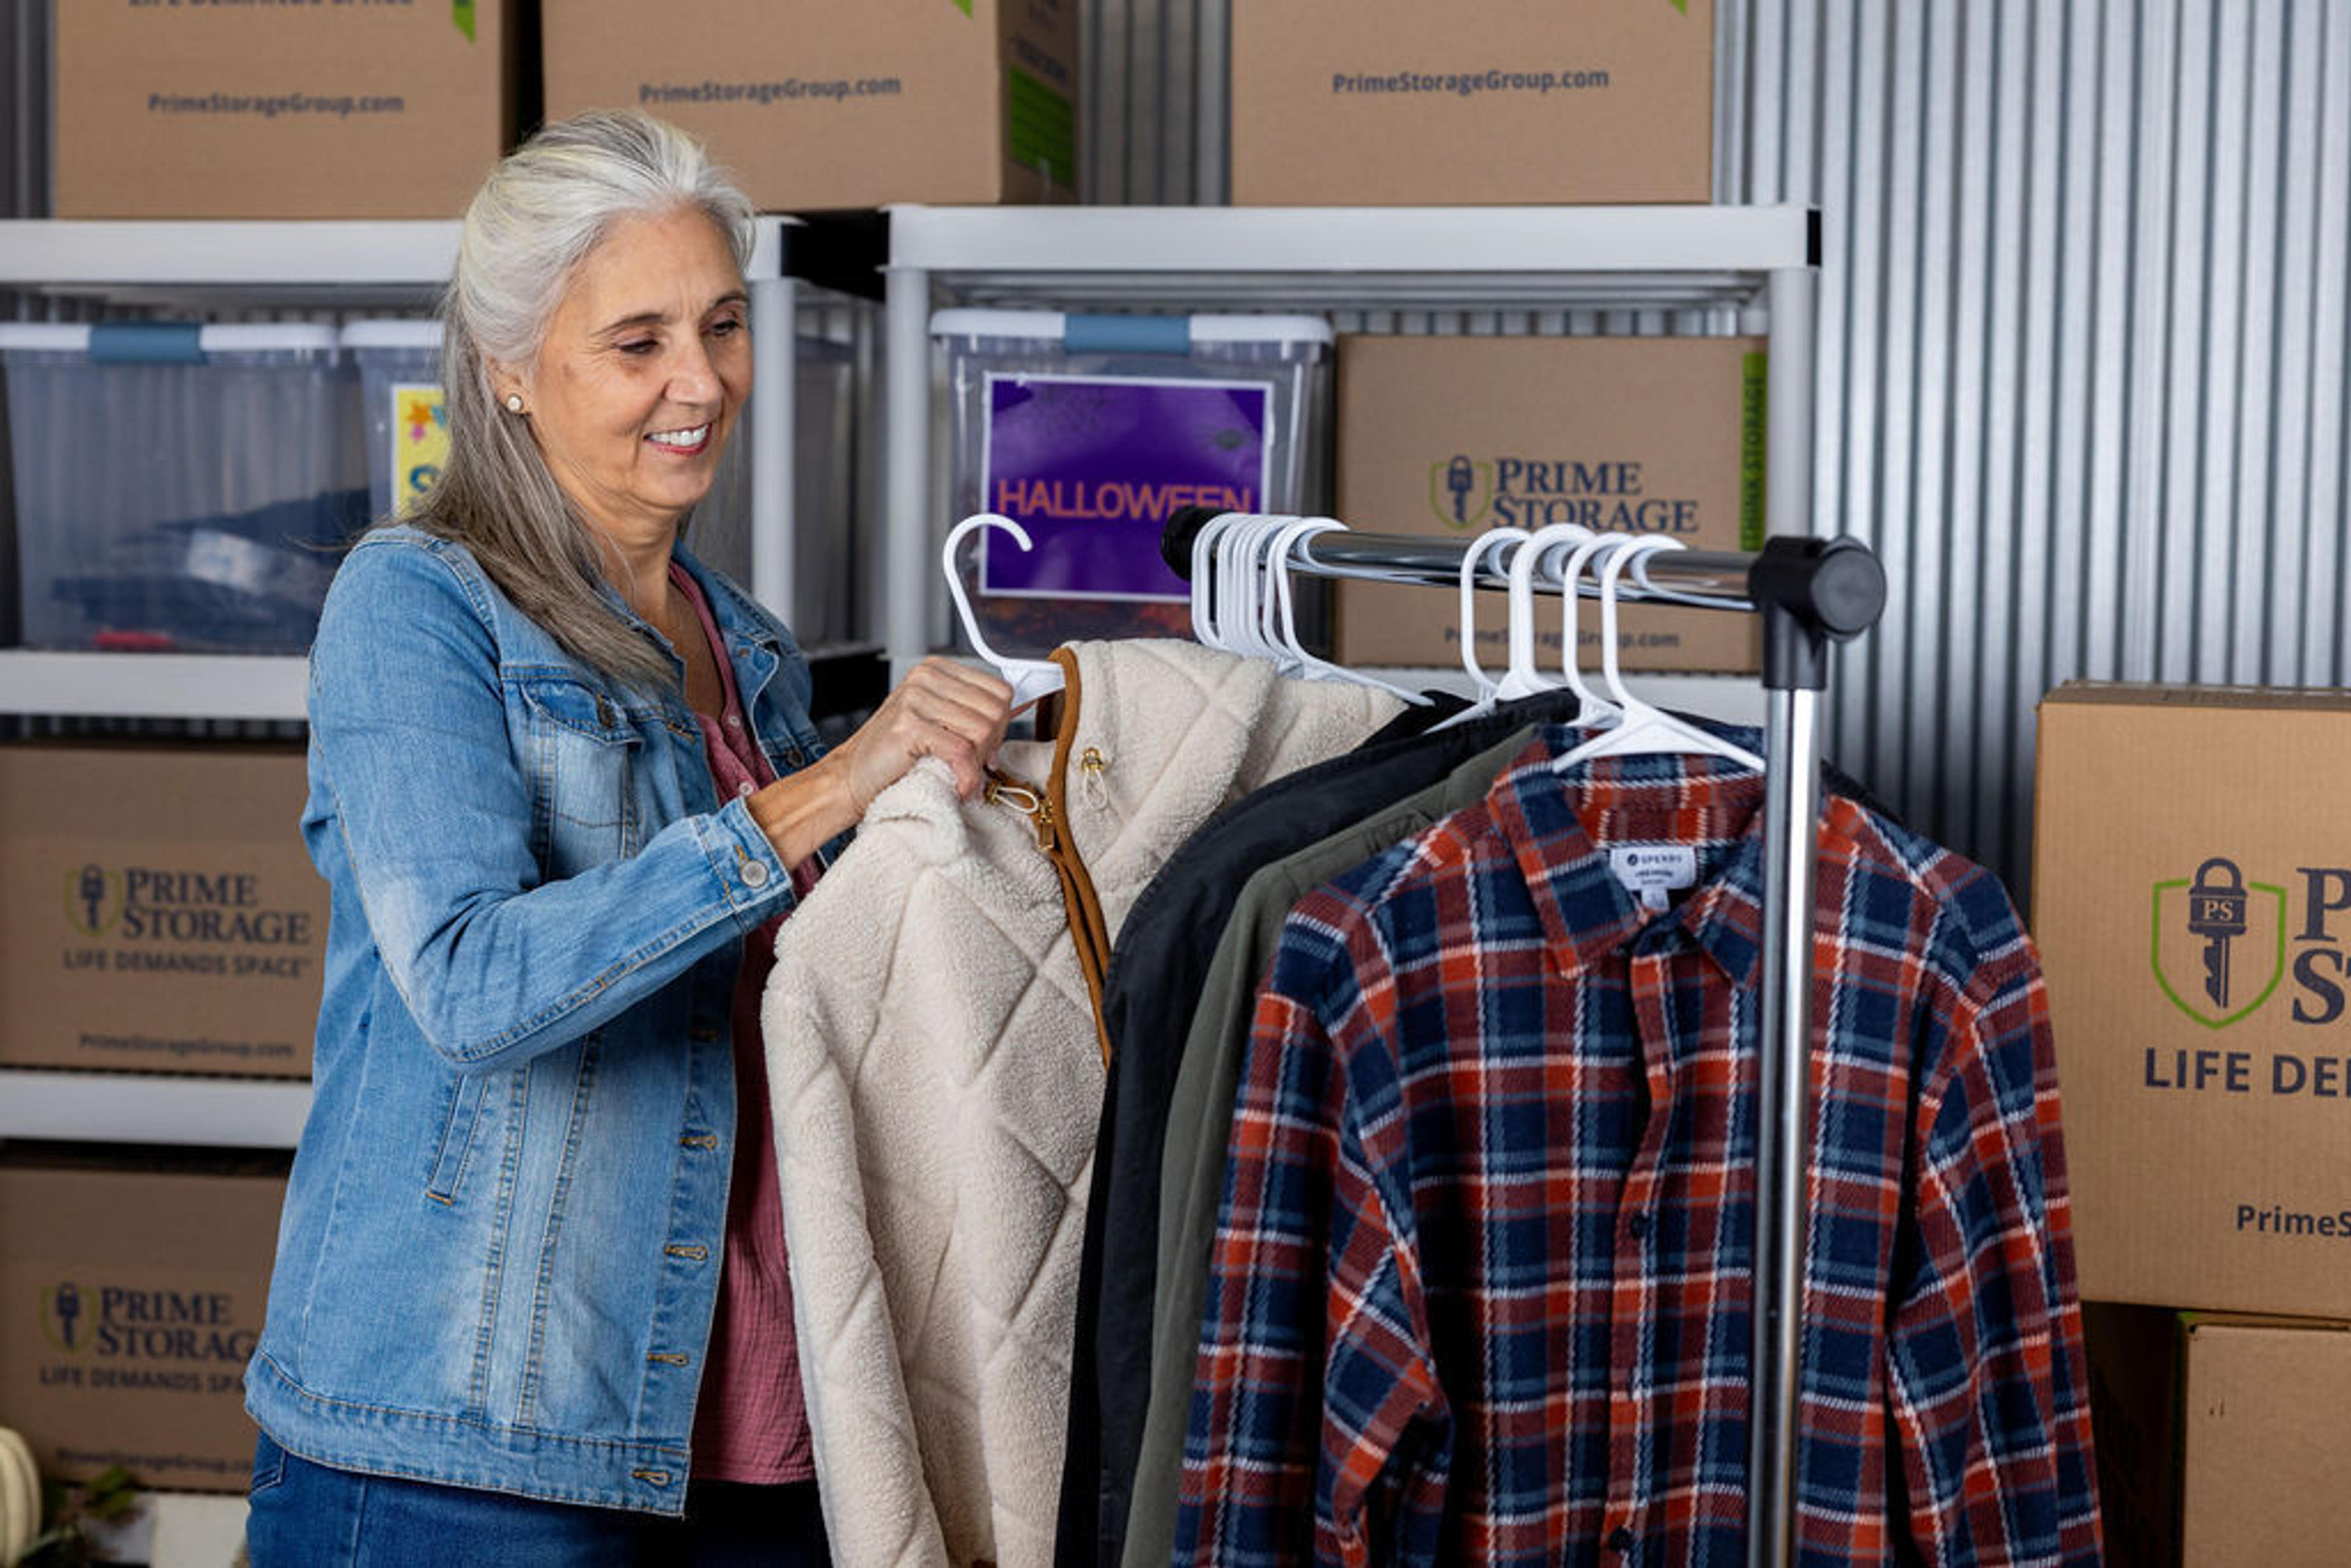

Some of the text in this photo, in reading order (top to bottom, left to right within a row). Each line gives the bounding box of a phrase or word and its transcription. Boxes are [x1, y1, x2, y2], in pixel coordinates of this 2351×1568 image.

[640, 75, 901, 103] PrimeStorageGroup.com
[1332, 70, 1609, 94] PrimeStorageGroup.com
[148, 93, 404, 116] PrimeStorageGroup.com
[1495, 459, 1642, 495] PRIME
[999, 479, 1250, 520] HALLOWEEN
[1491, 495, 1698, 533] STORAGE
[125, 868, 257, 906] PRIME
[122, 906, 311, 945] STORAGE
[2204, 899, 2233, 921] PS
[64, 950, 110, 969] LIFE
[117, 951, 227, 974] DEMANDS
[2292, 948, 2351, 1025] S
[2145, 1048, 2351, 1098] LIFE DE
[100, 1286, 233, 1325] PRIME
[97, 1322, 256, 1362] STORAG
